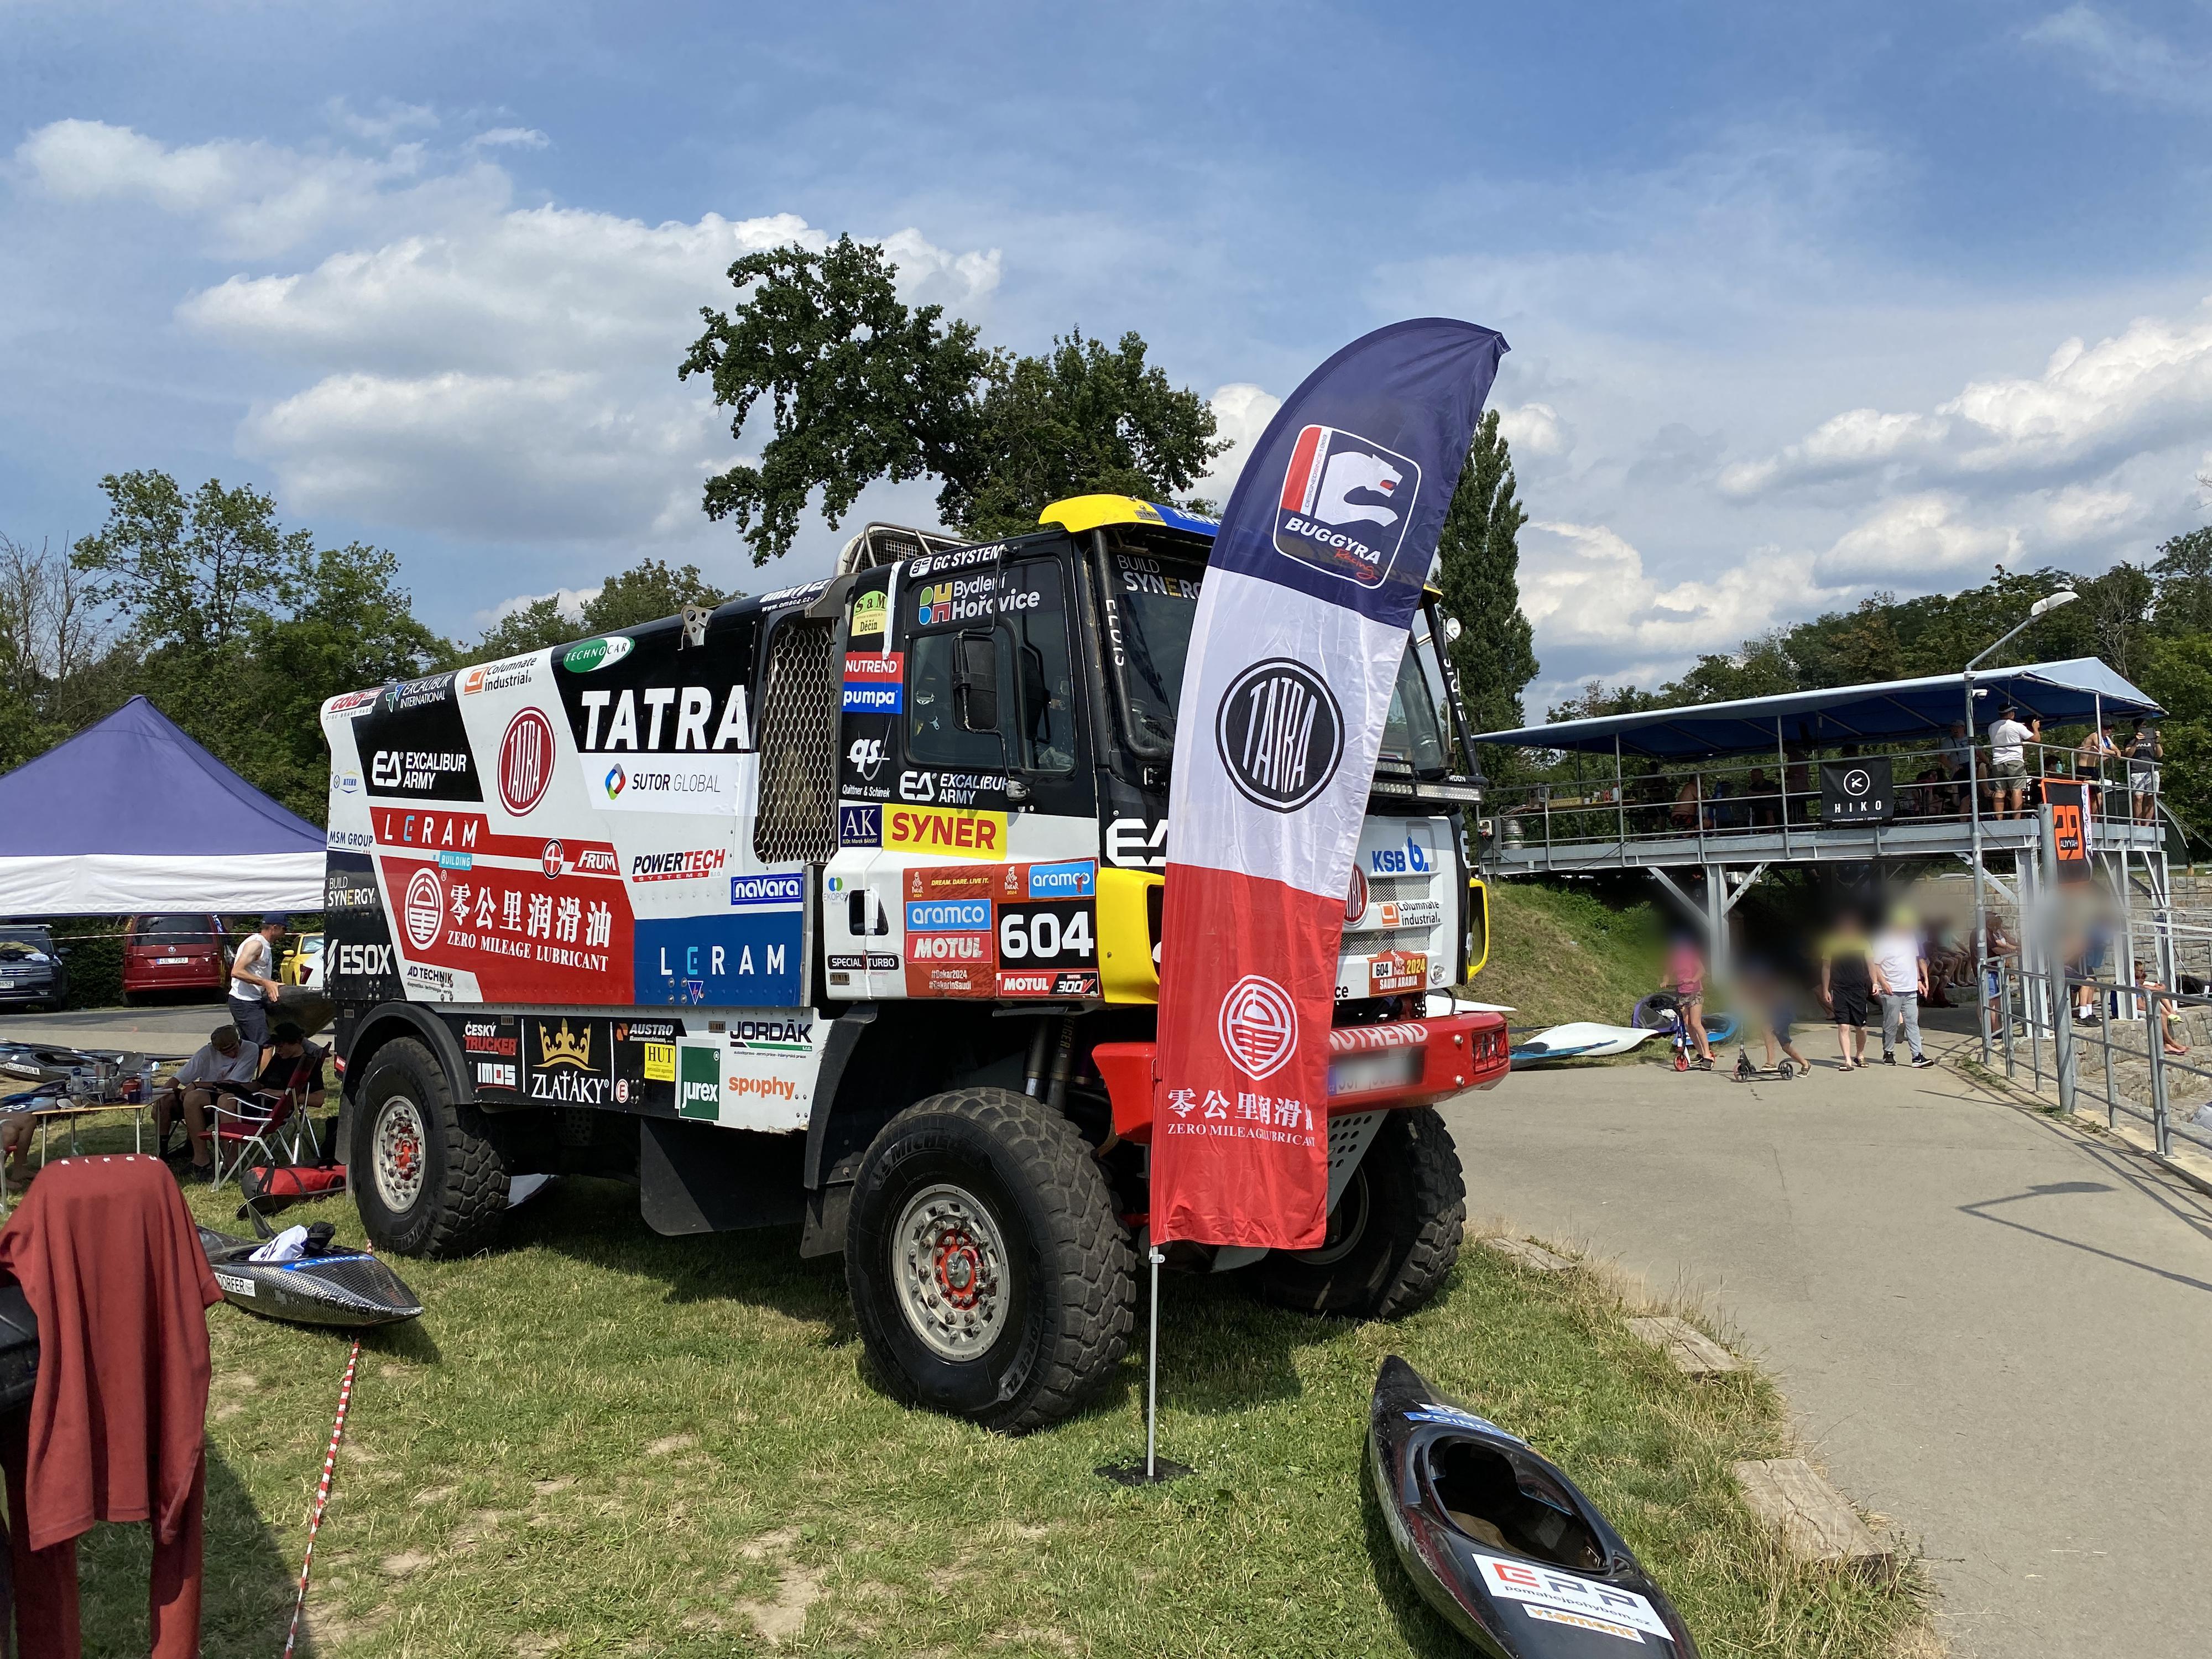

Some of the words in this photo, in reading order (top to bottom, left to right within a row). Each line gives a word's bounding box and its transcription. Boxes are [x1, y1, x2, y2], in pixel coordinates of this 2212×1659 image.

[1285, 517, 1381, 565] BUGGYRA
[933, 555, 951, 570] GC
[951, 544, 1005, 567] SYSTEM
[1117, 555, 1159, 573] BUILD
[953, 572, 1006, 599] Bydlení
[951, 588, 1040, 620] Hořovice
[860, 620, 878, 632] Děčín
[565, 643, 627, 662] TECHNOCAR
[487, 657, 537, 676] Columnate
[845, 660, 897, 673] NUTREND
[403, 674, 452, 696] EXCALIBUR
[485, 670, 528, 691] industrial
[331, 692, 366, 710] GOLD
[400, 690, 446, 708] INTERNATIONAL
[843, 691, 895, 707] pumpa
[582, 685, 750, 750] TATRA
[1242, 677, 1317, 792] TATRA
[406, 752, 467, 772] EXCALIBUR
[507, 721, 540, 804] TATRA
[403, 771, 436, 790] ARMY
[632, 774, 670, 791] SUTOR
[674, 774, 721, 792] GLOBAL
[842, 784, 863, 795] Quittner
[938, 789, 976, 805] ARMY
[1834, 800, 1882, 813] HIKO
[384, 814, 478, 848] LERAM
[842, 810, 878, 836] AK
[892, 812, 997, 851] SYNER
[329, 831, 346, 844] MSM
[348, 833, 373, 848] GROUP
[442, 855, 470, 867] BUILDING
[578, 851, 617, 870] FRUM
[633, 849, 726, 874] POWERTECH
[1372, 851, 1406, 872] KSB
[330, 877, 348, 889] BUILD
[638, 872, 703, 881] SYSTEMS
[1032, 872, 1090, 887] aramco
[327, 888, 375, 907] SYNERGY
[735, 879, 799, 898] navara
[449, 883, 612, 948] 零公里润滑油
[912, 906, 984, 925] aramco
[1396, 901, 1439, 911] Columnate
[1401, 912, 1438, 926] industrial
[1000, 911, 1094, 959] 604
[447, 930, 476, 949] ZERO
[480, 935, 531, 959] MILEAGE
[536, 945, 608, 972] LUBRICANT
[914, 937, 983, 958] MOTUL
[340, 945, 392, 974] ESOX
[660, 944, 785, 975] LERAM
[832, 958, 862, 967] SPECIAL
[868, 958, 895, 967] TURBO
[1376, 963, 1389, 976] 604
[1407, 958, 1426, 974] 2024
[407, 966, 418, 977] AD
[419, 967, 452, 983] TECHNIK
[931, 969, 967, 979] #Dakar2024
[1380, 978, 1396, 990] SAUDI
[1397, 975, 1417, 988] ARABIA
[1003, 978, 1049, 991] MOTUL
[1057, 979, 1095, 994] 300V
[465, 1020, 496, 1037] ČESKÝ
[629, 1024, 674, 1036] AUSTRO
[465, 1036, 517, 1052] TRUCKER
[648, 1046, 673, 1063] HUT
[477, 1062, 515, 1086] IMOS
[531, 1071, 604, 1104] ZLAŤÁKY
[619, 1084, 626, 1098] E
[682, 1081, 718, 1109] jurex
[729, 1077, 795, 1099] spophy
[1168, 1123, 1206, 1135] ZERO
[316, 1255, 367, 1264] UNIQA
